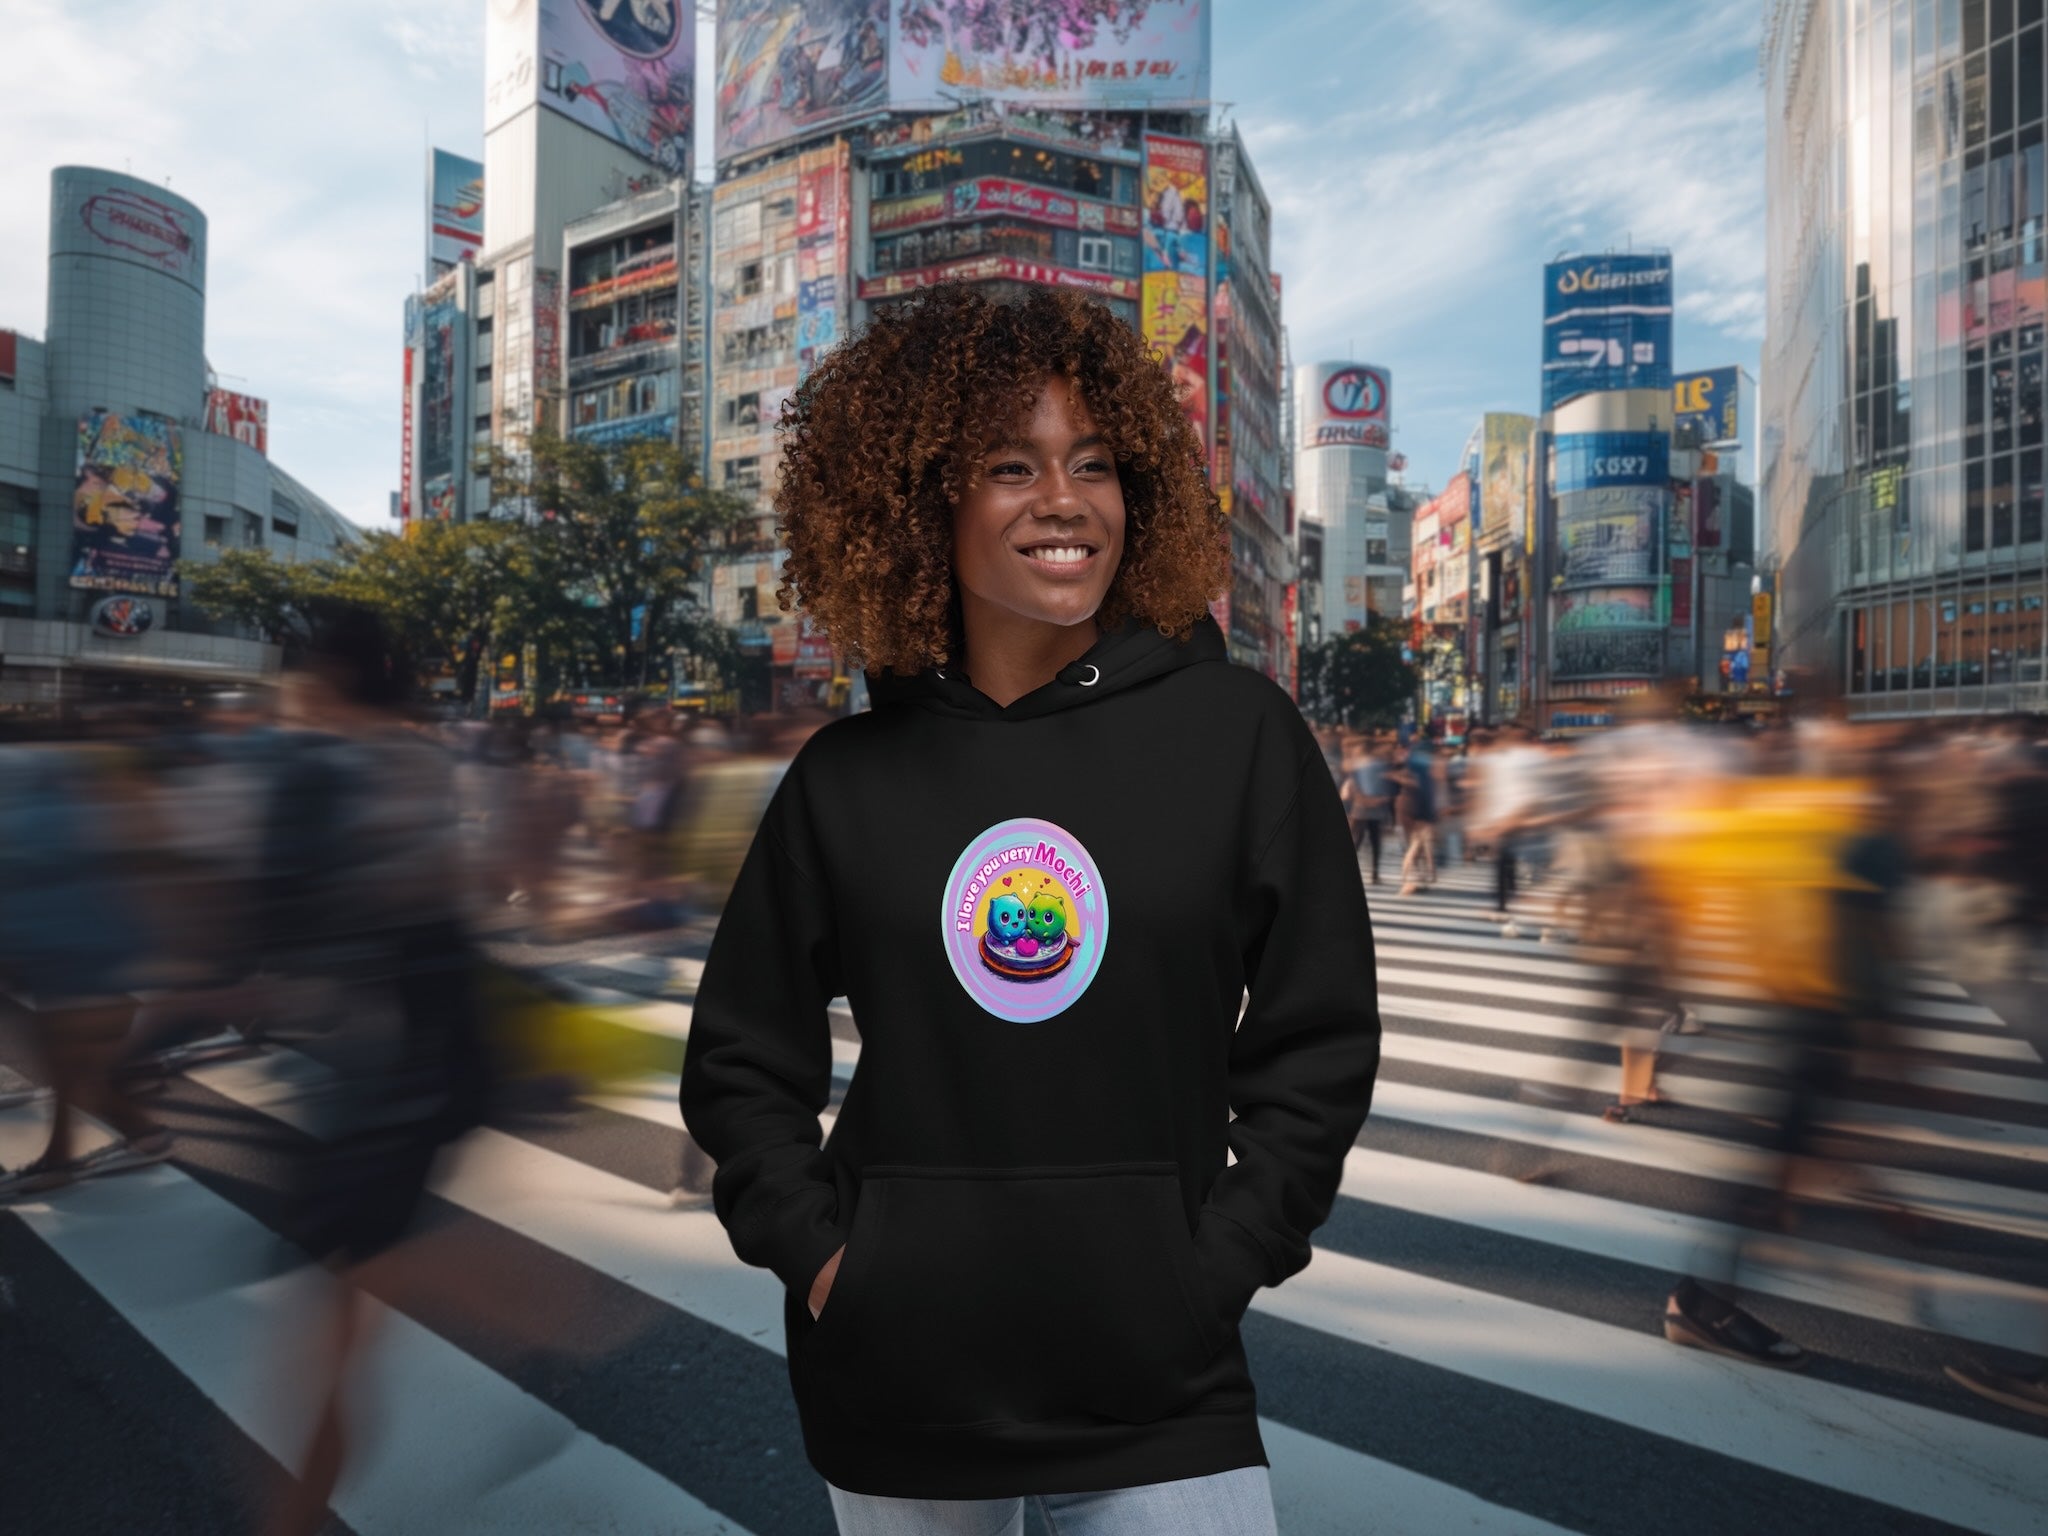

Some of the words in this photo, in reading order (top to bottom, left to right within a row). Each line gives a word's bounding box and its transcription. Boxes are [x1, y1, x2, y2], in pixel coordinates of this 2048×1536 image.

[1000, 846, 1034, 864] very
[1034, 841, 1091, 898] Mochi
[975, 856, 1001, 887] you
[958, 882, 980, 919] love
[957, 920, 971, 931] I
